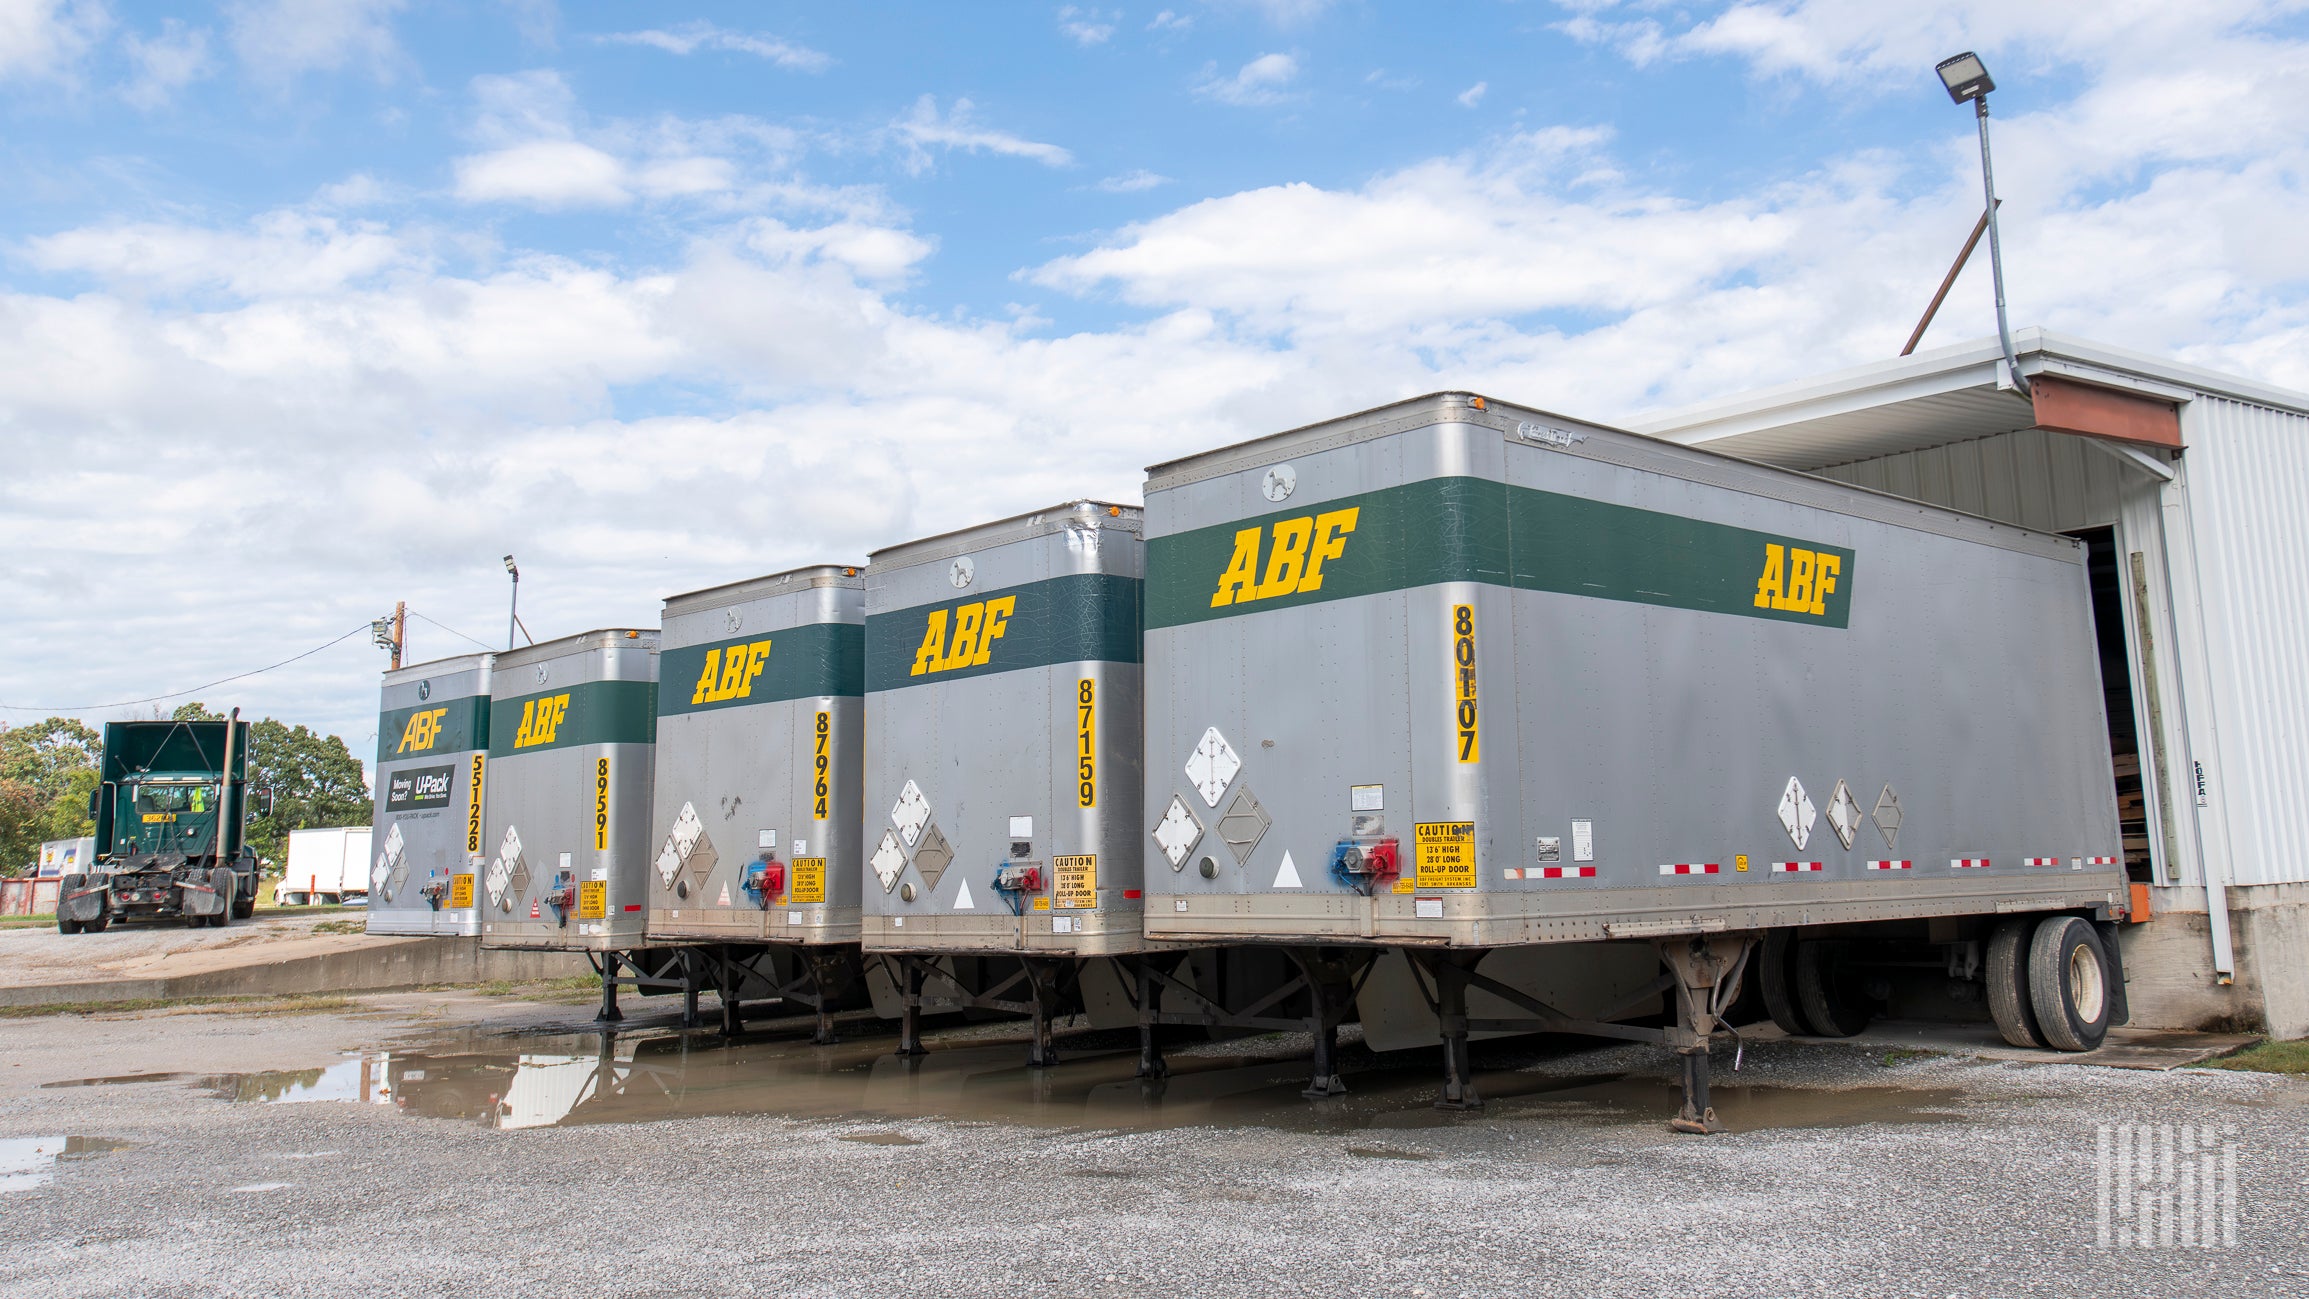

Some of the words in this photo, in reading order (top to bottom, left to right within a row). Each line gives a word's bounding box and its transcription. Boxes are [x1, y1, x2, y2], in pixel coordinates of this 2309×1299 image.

[1210, 506, 1360, 608] ABF
[1753, 544, 1841, 615] ABF
[910, 595, 1017, 676] ABF
[692, 639, 773, 705] ABF
[1456, 606, 1476, 761] 80107
[396, 707, 448, 754] ABF
[513, 693, 571, 749] ABF
[1079, 679, 1094, 807] 87159
[391, 790, 408, 802] Soon?
[393, 778, 412, 790] Moving
[415, 772, 450, 795] U-Pack
[815, 712, 829, 819] 87964
[468, 755, 483, 852] 551228
[597, 758, 608, 849] 89591
[792, 859, 823, 868] CAUTION
[1055, 857, 1092, 867] CAUTION
[1420, 865, 1446, 873] ROLL-UP
[1449, 865, 1469, 873] DOOR
